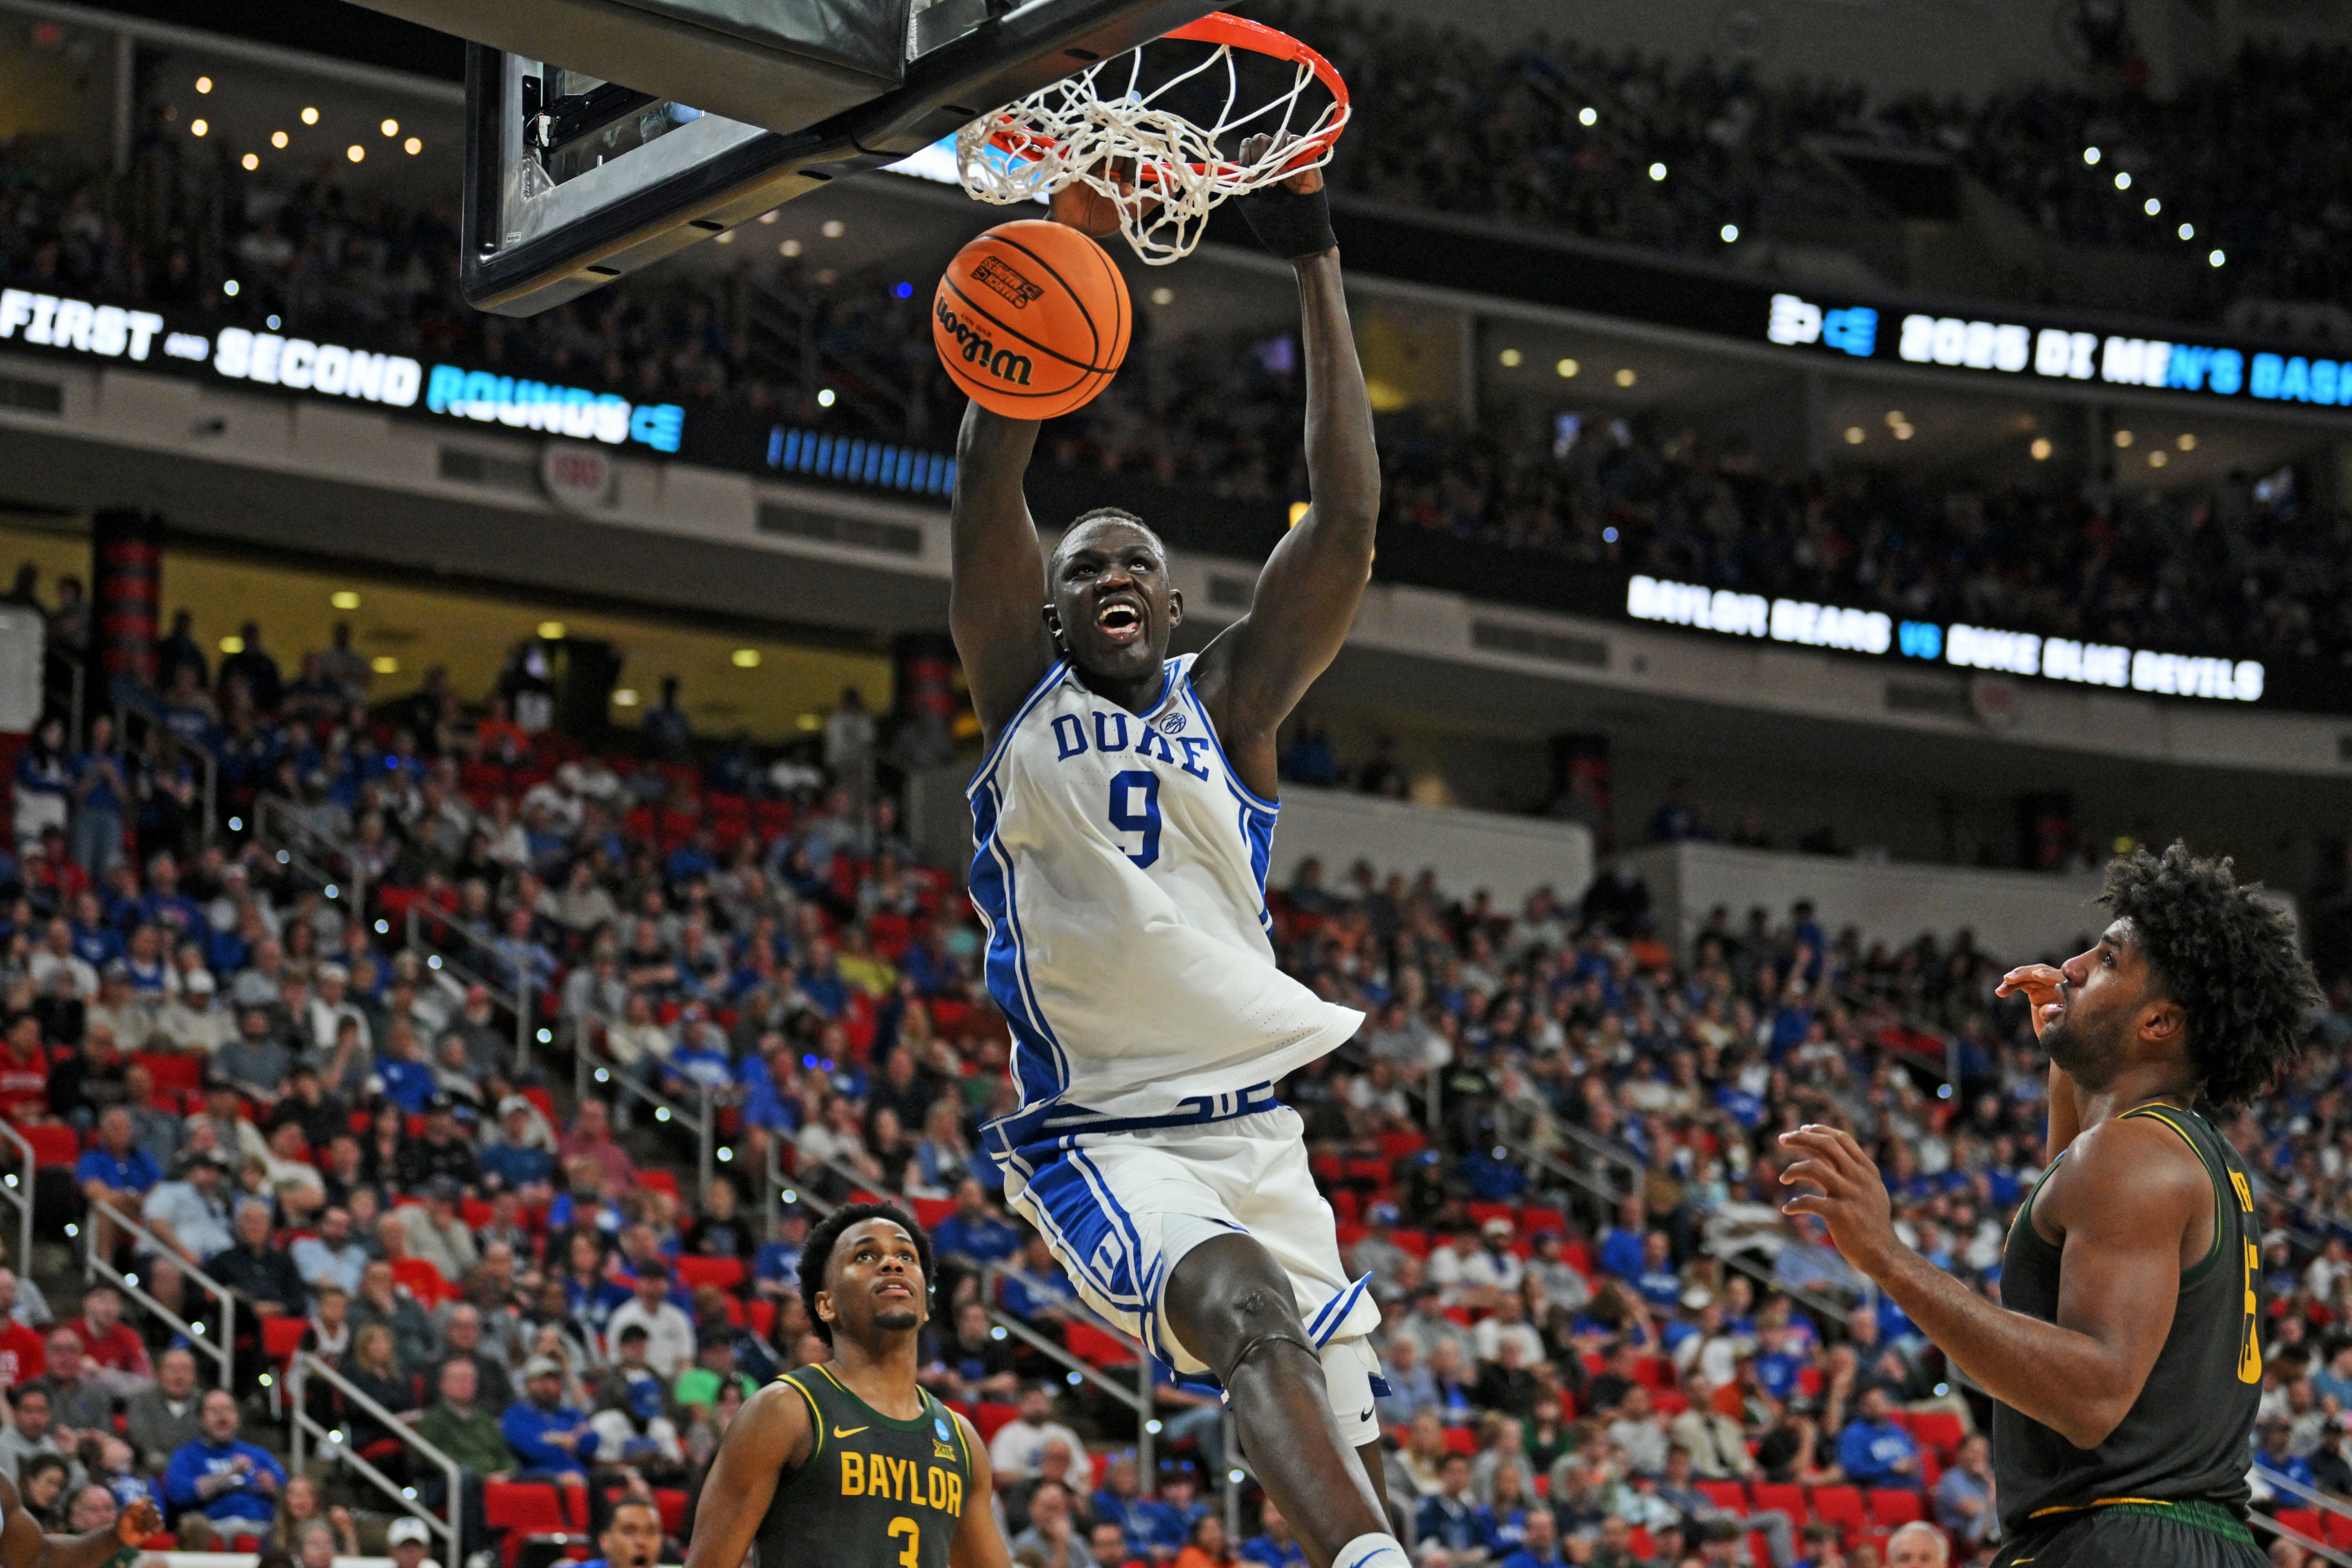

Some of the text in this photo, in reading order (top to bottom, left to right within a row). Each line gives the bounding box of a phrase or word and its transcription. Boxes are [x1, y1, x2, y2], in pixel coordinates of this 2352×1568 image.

[980, 258, 1023, 291] MADNESS
[985, 274, 1019, 301] MARCH
[0, 288, 164, 360] FIRST
[214, 327, 421, 406] SECOND
[427, 364, 632, 444] ROUNDS
[936, 292, 1032, 386] Wilson
[1900, 314, 2029, 371] 2025
[2102, 336, 2243, 394] MEN'S
[1628, 575, 2264, 701] BAYLOR BEARS VS DUKE BLUE DEVILS
[1051, 711, 1210, 782] DUKE
[1109, 770, 1162, 869] 9
[840, 1451, 962, 1518] BAYLOR
[887, 1516, 920, 1568] 3
